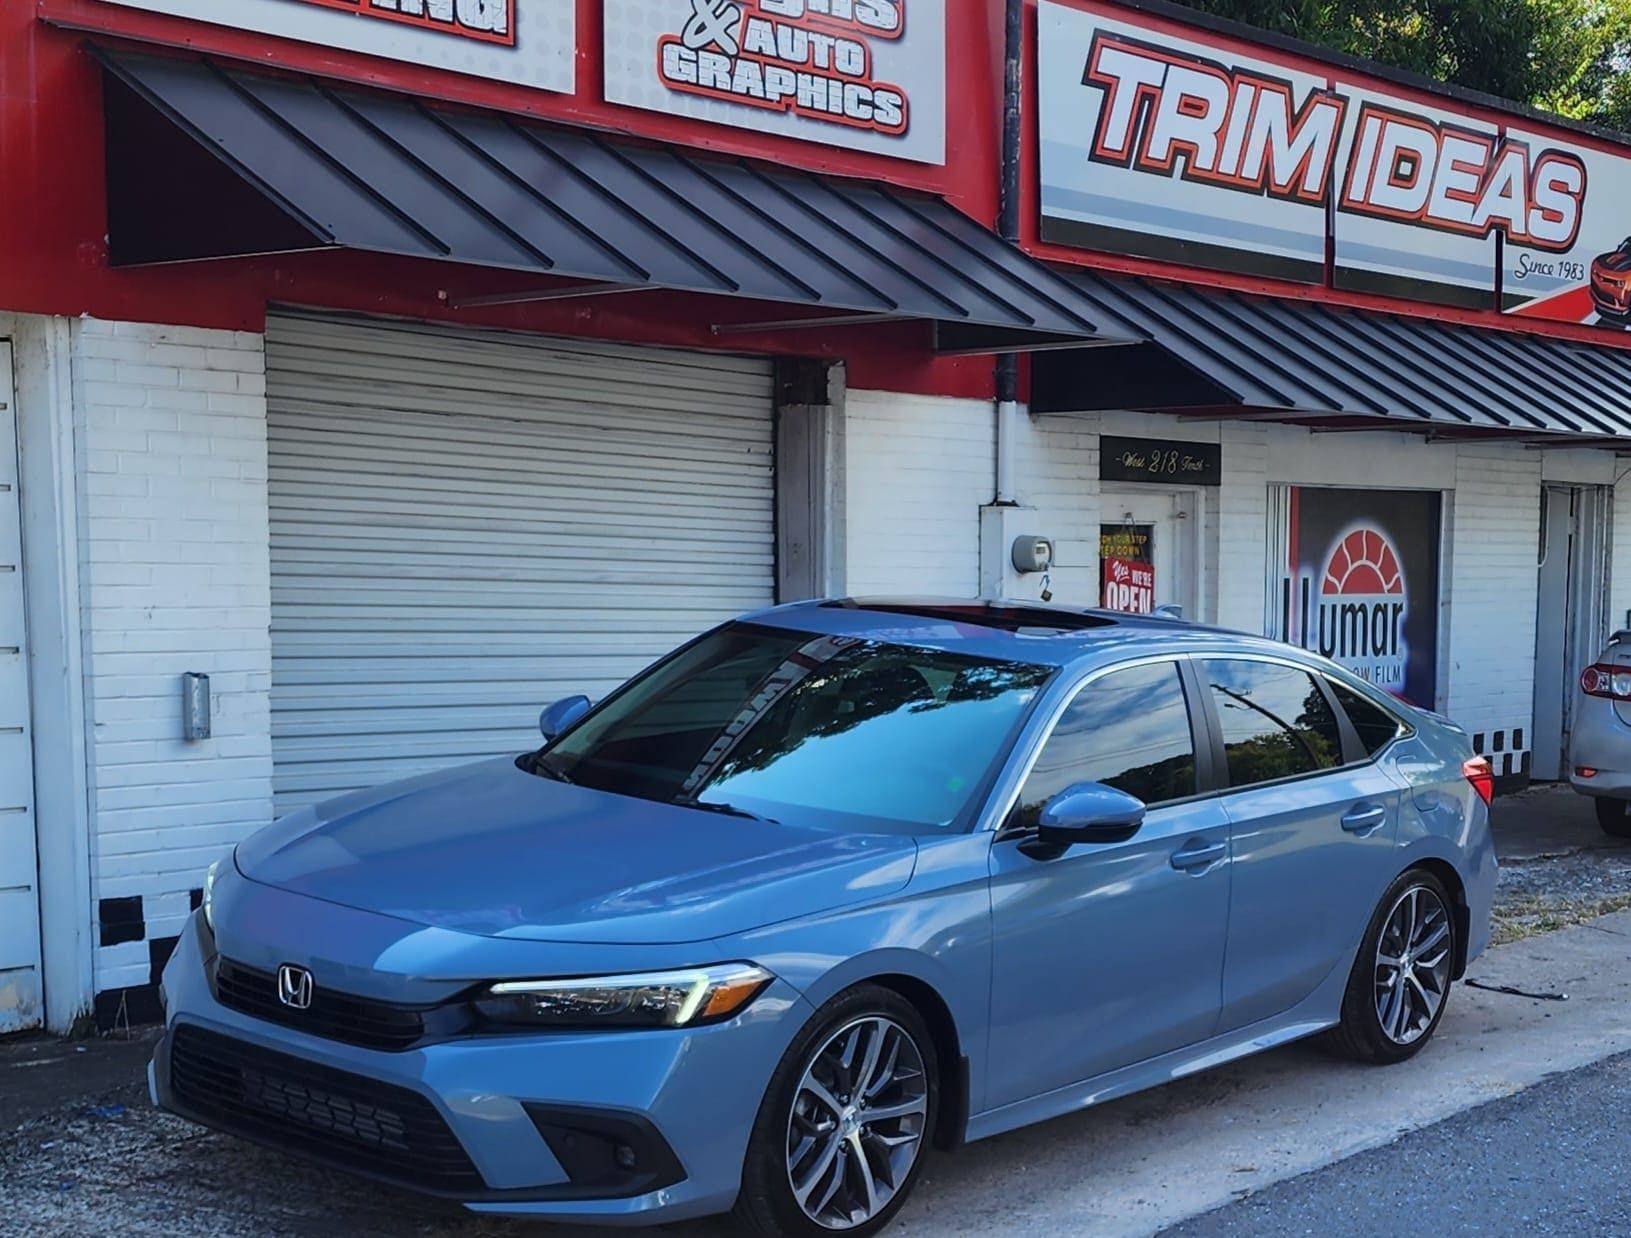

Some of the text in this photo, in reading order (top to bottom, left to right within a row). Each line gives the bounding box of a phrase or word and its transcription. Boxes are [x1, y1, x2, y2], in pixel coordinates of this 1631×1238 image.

[744, 17, 866, 77] AUTO
[662, 42, 903, 126] GRAPHICS
[1092, 40, 1586, 248] TRIM IDEAS
[1514, 253, 1585, 281] Since 1983
[1148, 449, 1179, 474] 218
[1112, 560, 1130, 582] Yes
[1106, 580, 1152, 614] OPEN
[1375, 665, 1401, 684] FILM
